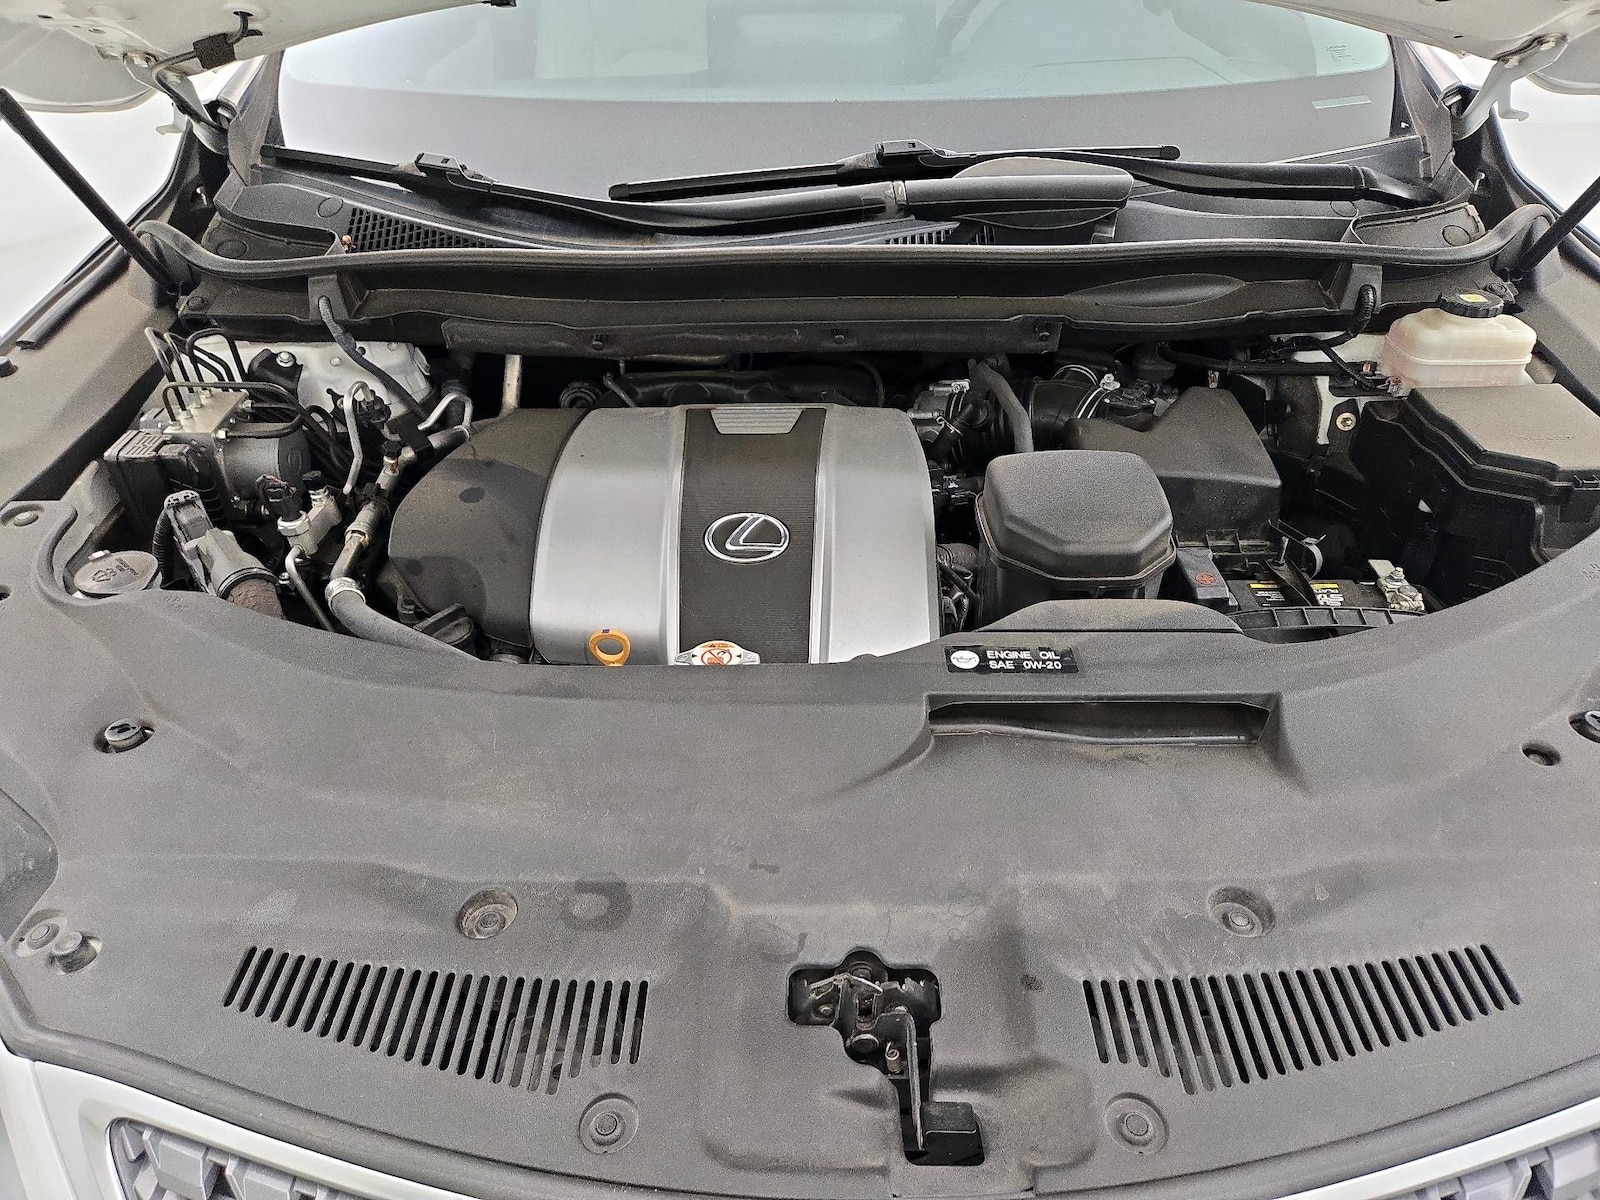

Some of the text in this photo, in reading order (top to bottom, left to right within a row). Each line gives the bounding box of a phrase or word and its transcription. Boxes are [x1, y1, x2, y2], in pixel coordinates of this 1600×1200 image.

[986, 650, 1060, 659] ENGINE OIL
[988, 660, 1062, 669] SAE 0W-20
